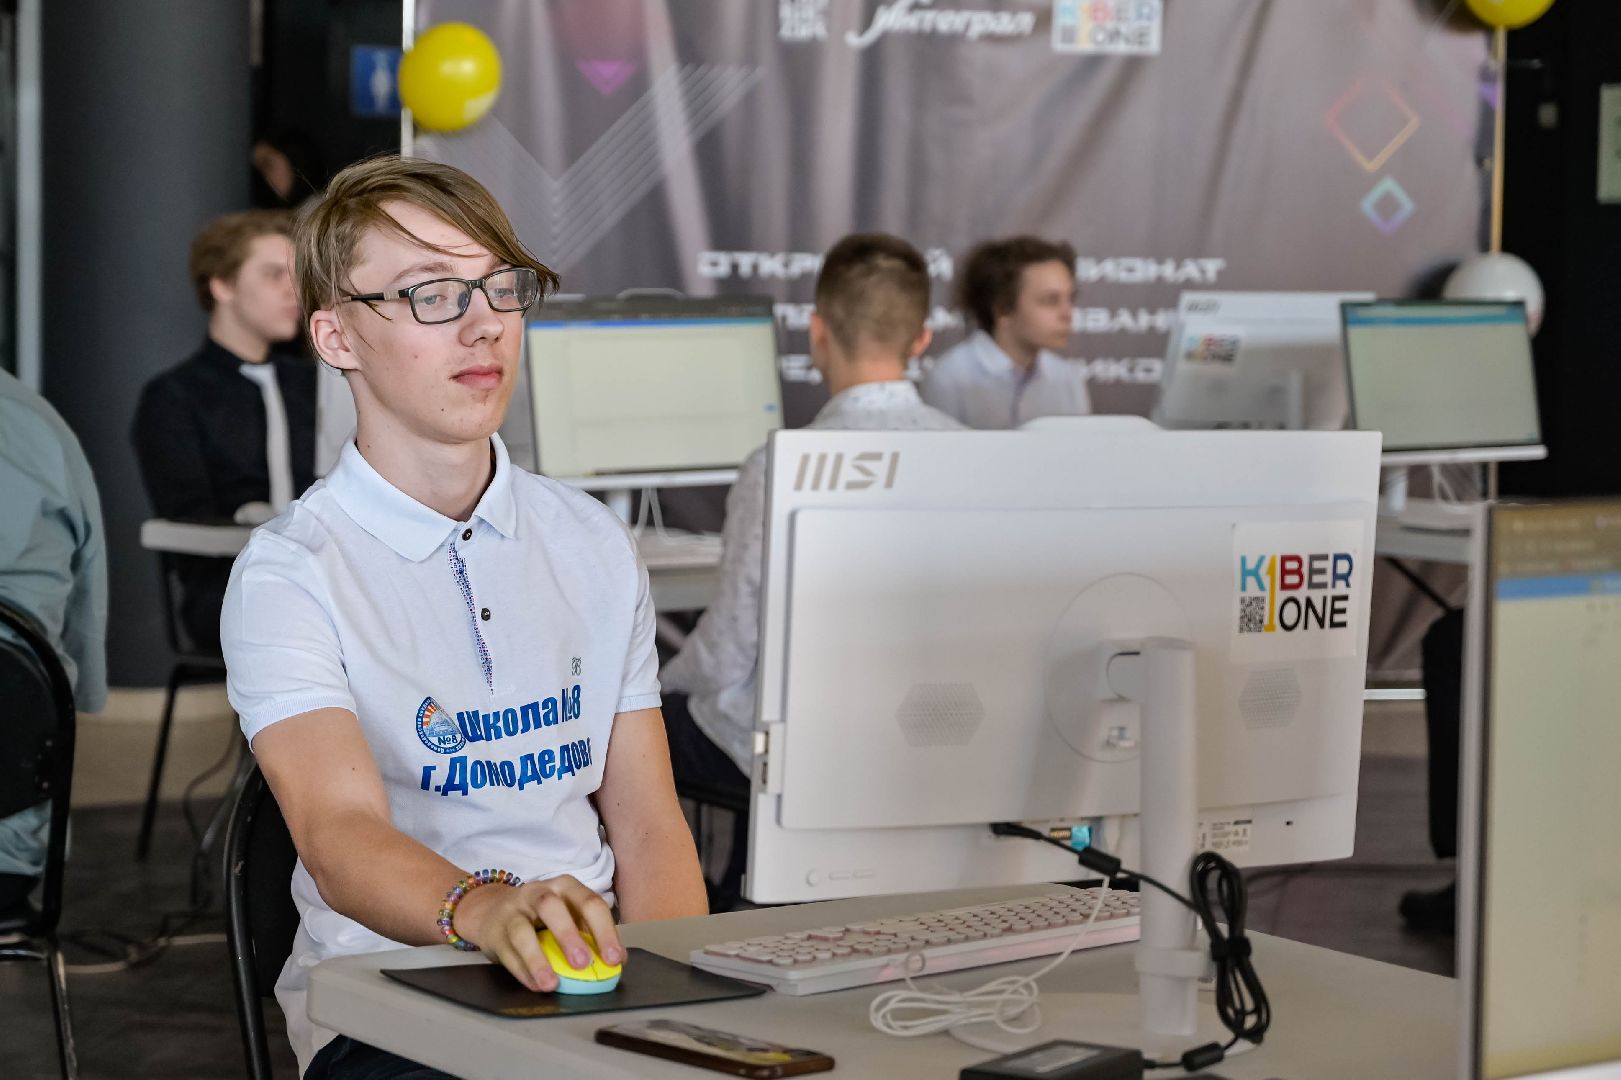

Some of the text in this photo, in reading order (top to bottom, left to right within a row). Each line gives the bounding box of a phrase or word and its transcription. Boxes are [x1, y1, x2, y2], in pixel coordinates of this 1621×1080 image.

[793, 451, 900, 491] MSI
[1278, 594, 1349, 631] ONE
[456, 697, 558, 742] Школа
